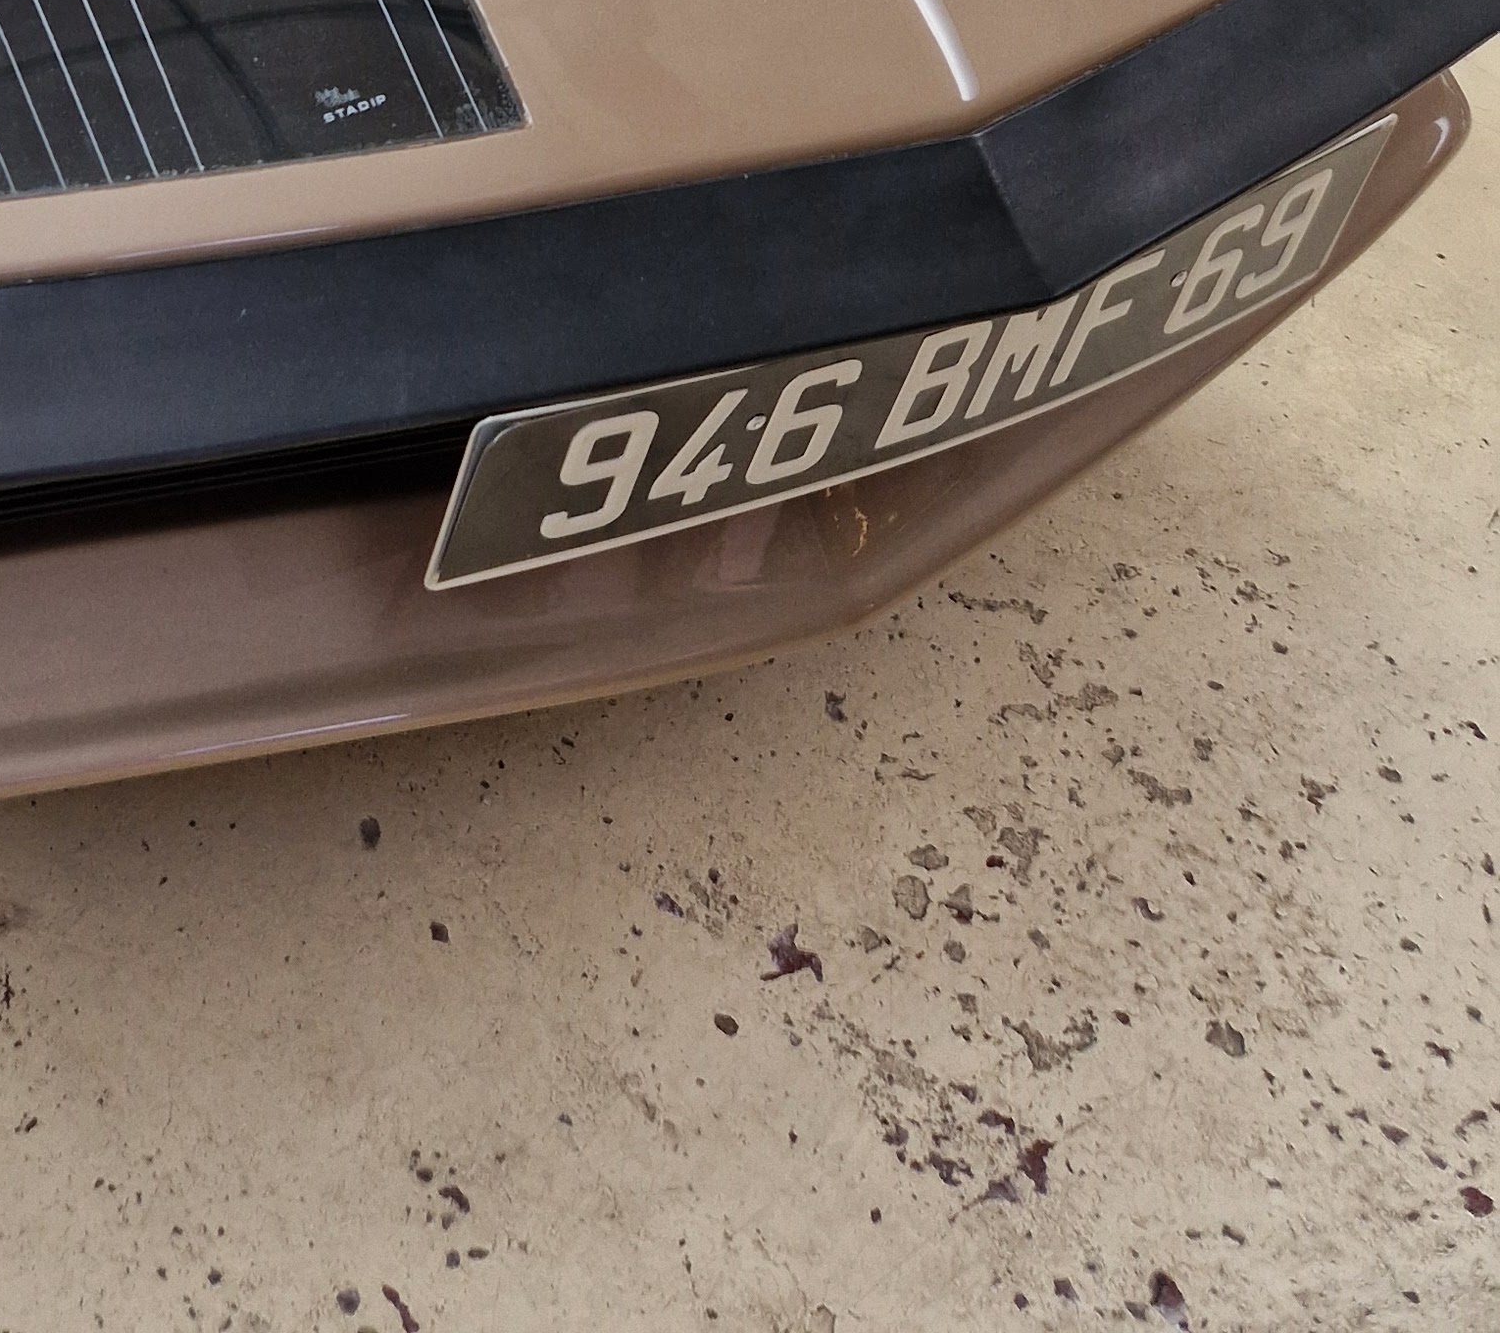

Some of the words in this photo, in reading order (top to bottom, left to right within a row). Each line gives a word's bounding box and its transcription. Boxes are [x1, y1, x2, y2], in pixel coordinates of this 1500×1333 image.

[322, 94, 387, 125] STADIP
[540, 357, 864, 540] 946
[875, 249, 1165, 450] BMF
[1162, 167, 1333, 336] 69
